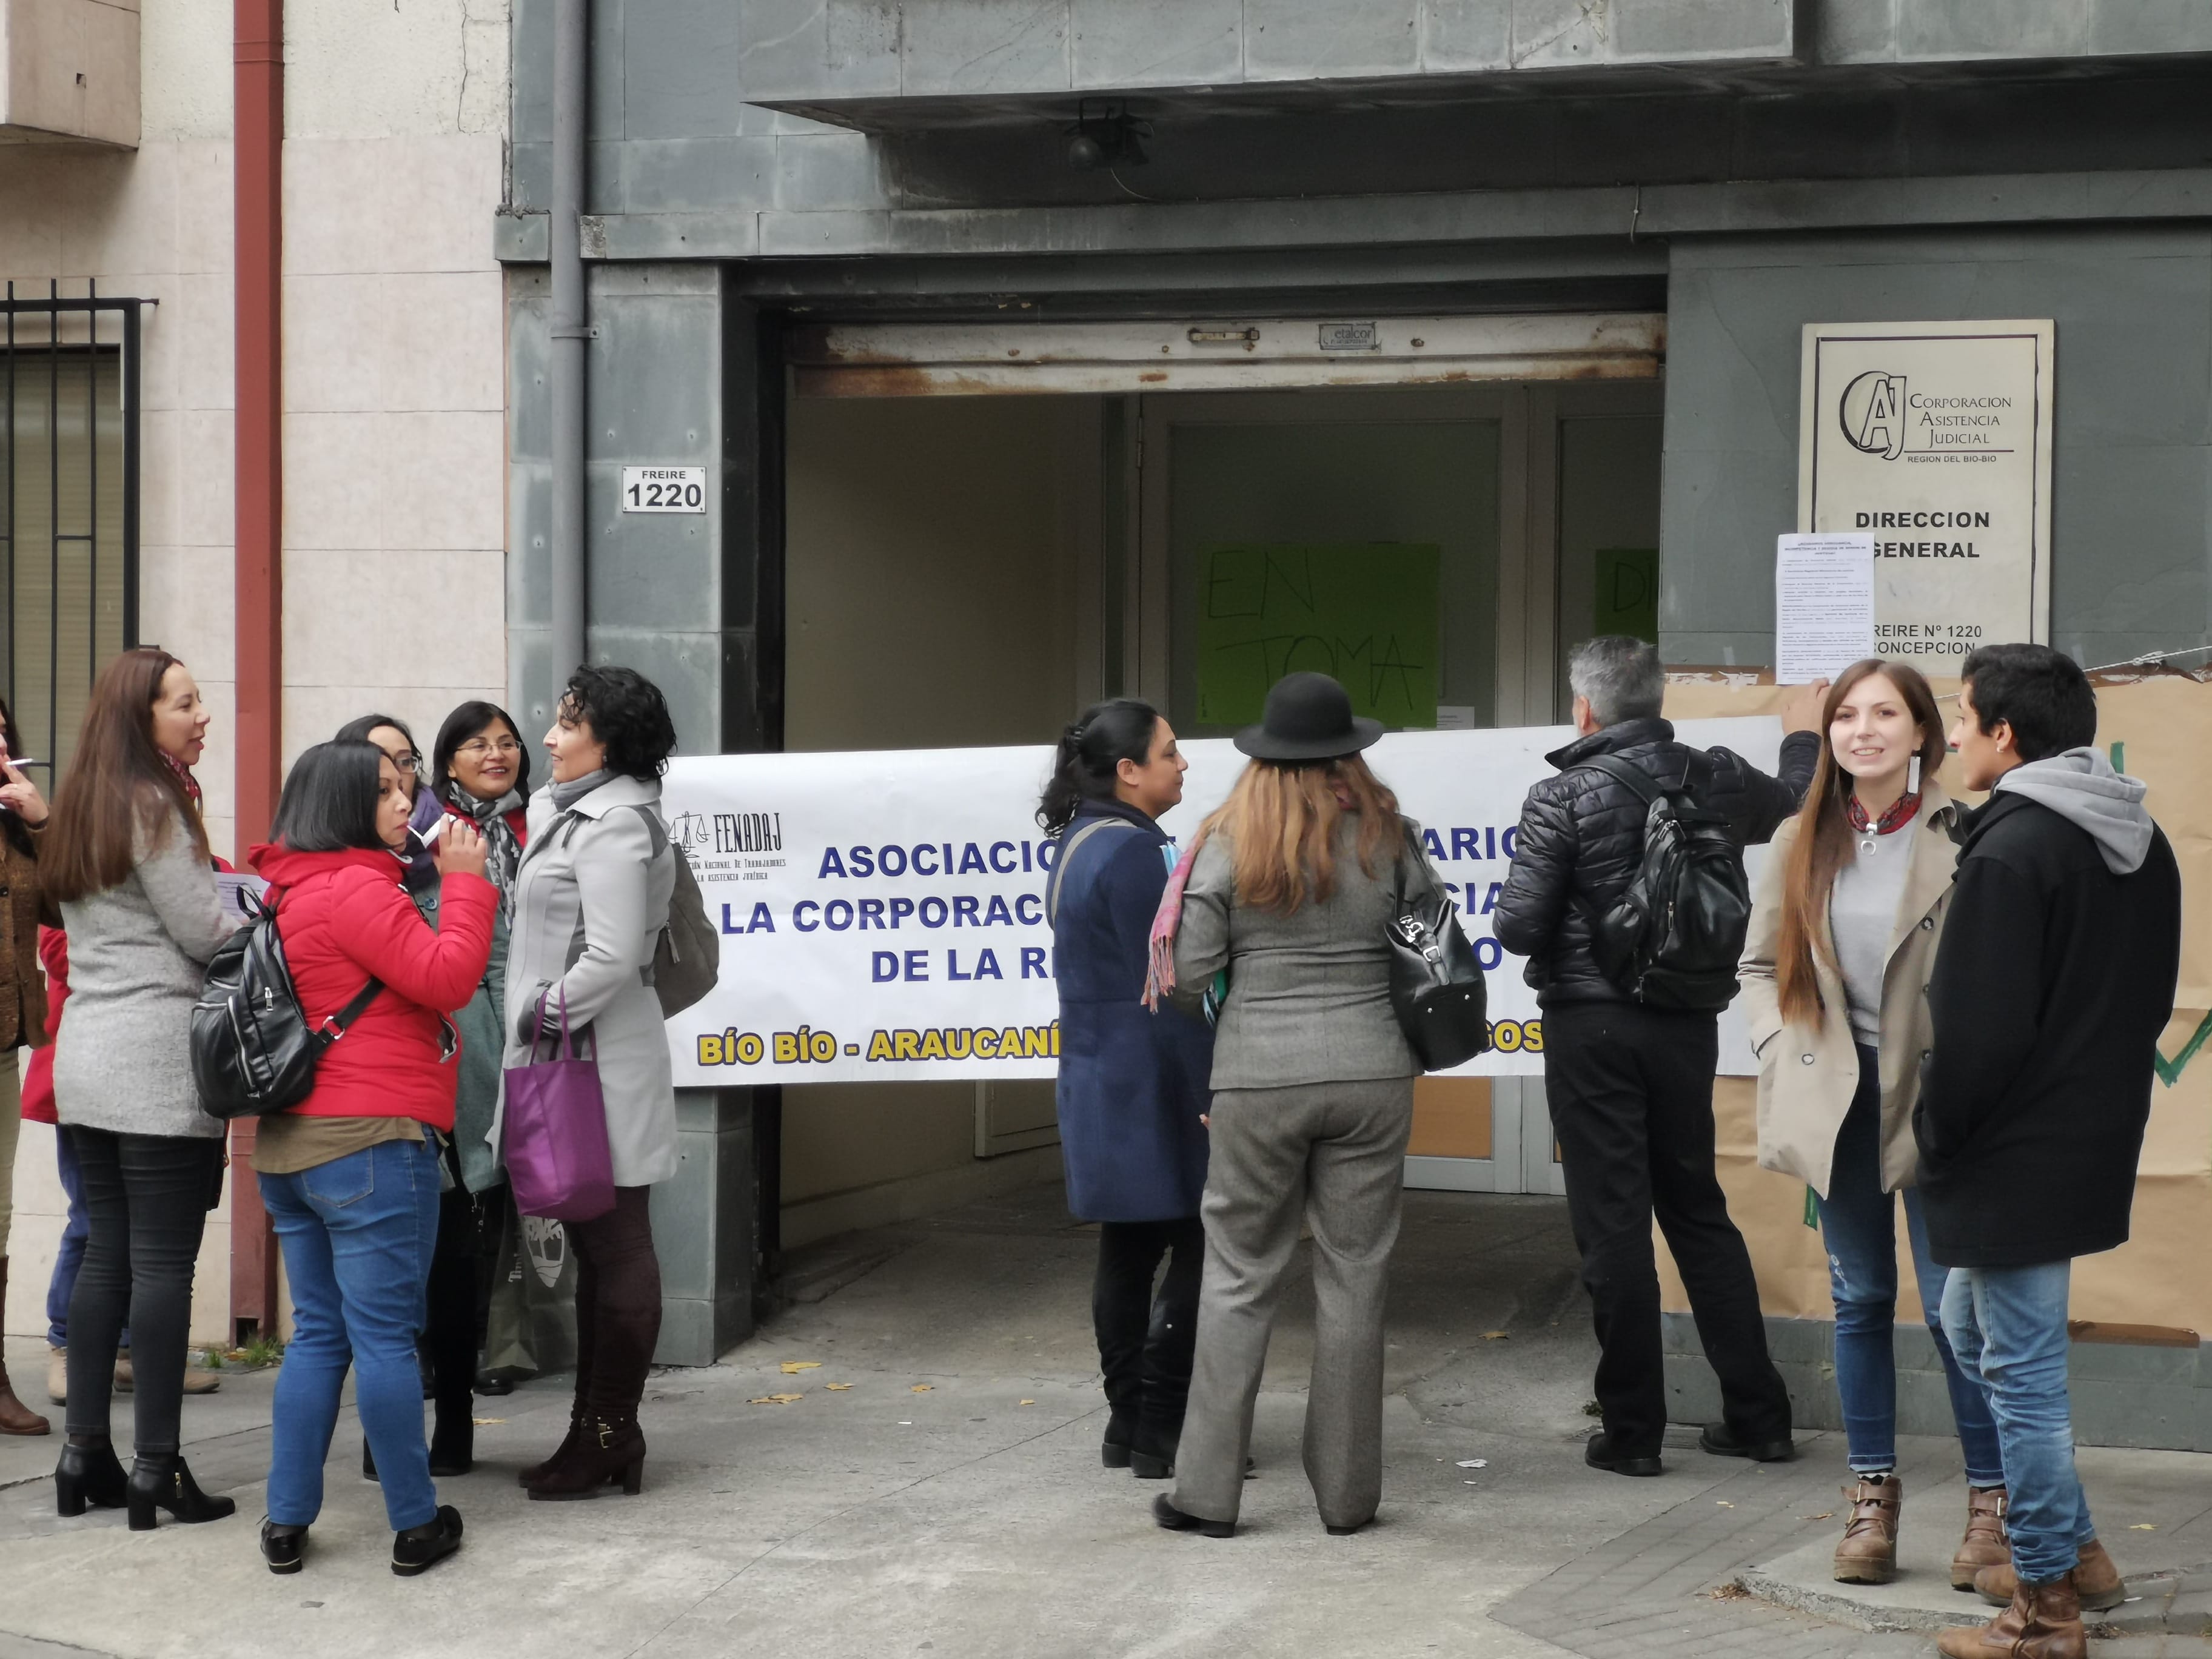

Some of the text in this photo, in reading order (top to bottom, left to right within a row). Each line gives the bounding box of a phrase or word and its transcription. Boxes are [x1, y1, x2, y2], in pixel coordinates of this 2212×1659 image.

[1333, 324, 1372, 339] etalcor
[1910, 394, 2011, 408] CORPORACION
[1920, 411, 2000, 426] ASISTENCIA
[1929, 429, 1989, 448] JUDICIAL
[642, 471, 686, 479] FREIRE
[628, 483, 702, 507] 1220
[1855, 512, 1989, 528] DIRECCION
[1207, 548, 1315, 619] EN
[1947, 625, 1982, 637] 1220
[1874, 642, 1975, 654] ONCEPCION
[1215, 634, 1424, 711] TOMA
[713, 813, 782, 853] FENADAJ
[722, 902, 776, 934] LA
[793, 894, 1043, 932] CORPORAC
[872, 950, 929, 982] DE
[948, 948, 1004, 980] LA
[1021, 946, 1056, 979] R
[697, 1027, 764, 1066] BÍO
[773, 1025, 837, 1064] BÍO
